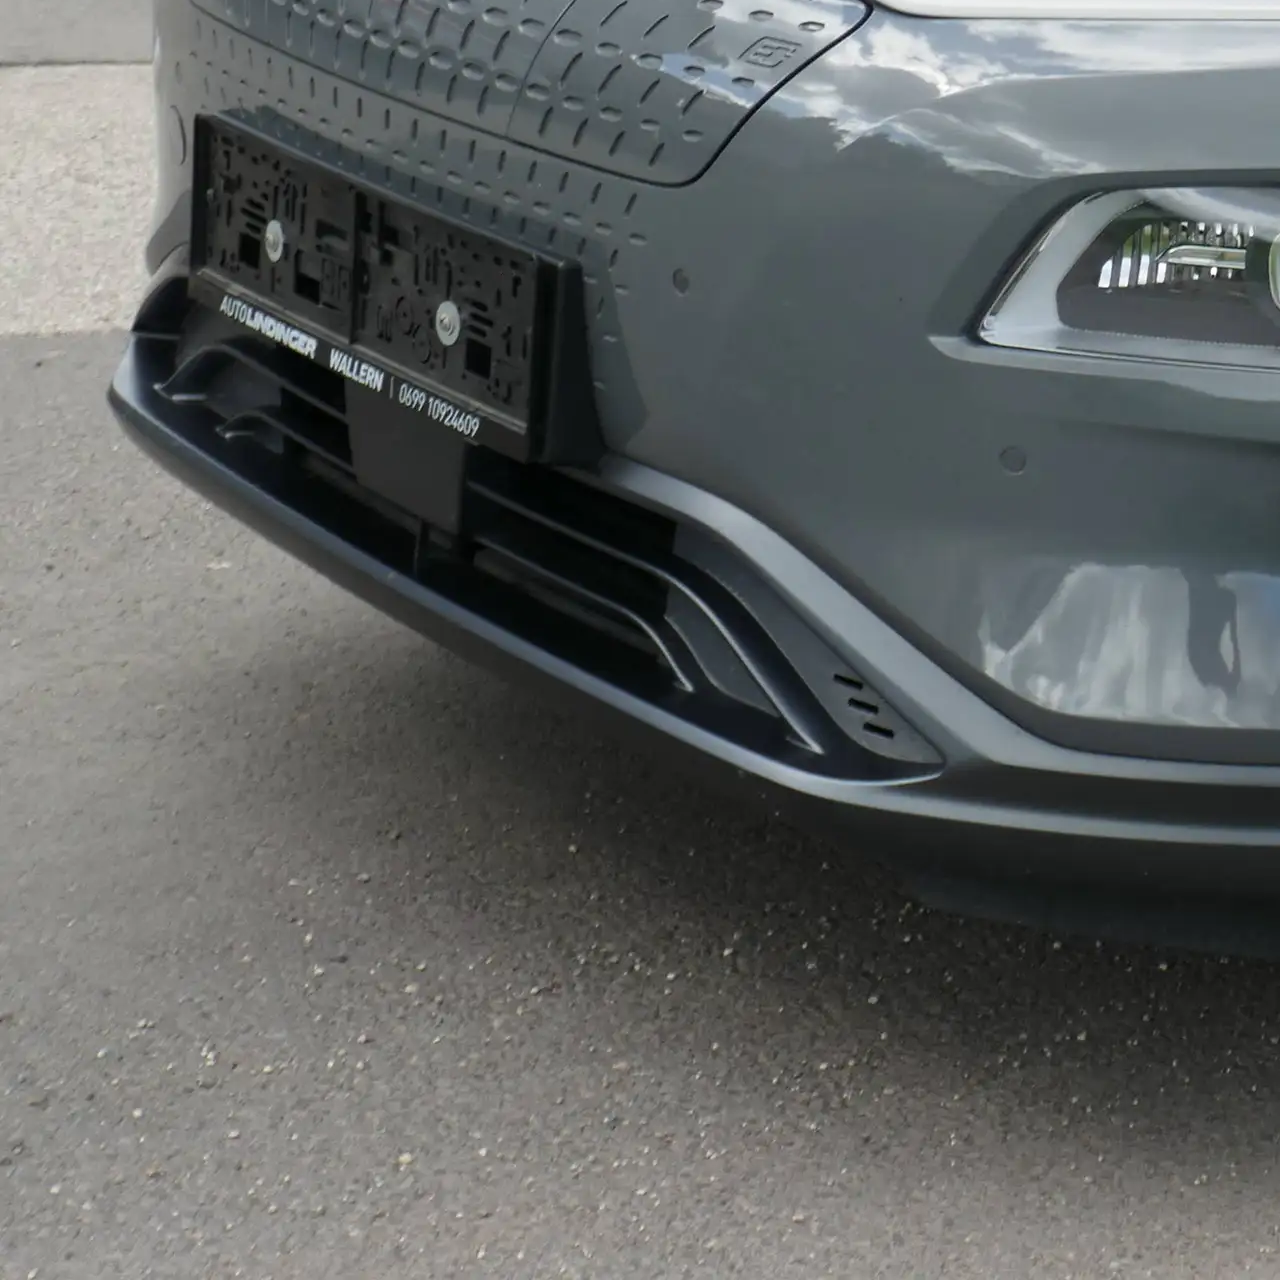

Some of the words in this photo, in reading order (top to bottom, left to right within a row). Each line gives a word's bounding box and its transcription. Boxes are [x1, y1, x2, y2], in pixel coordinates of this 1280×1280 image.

[329, 348, 384, 392] WALLERN
[399, 384, 426, 412] 0699
[427, 397, 480, 437] 10924609
